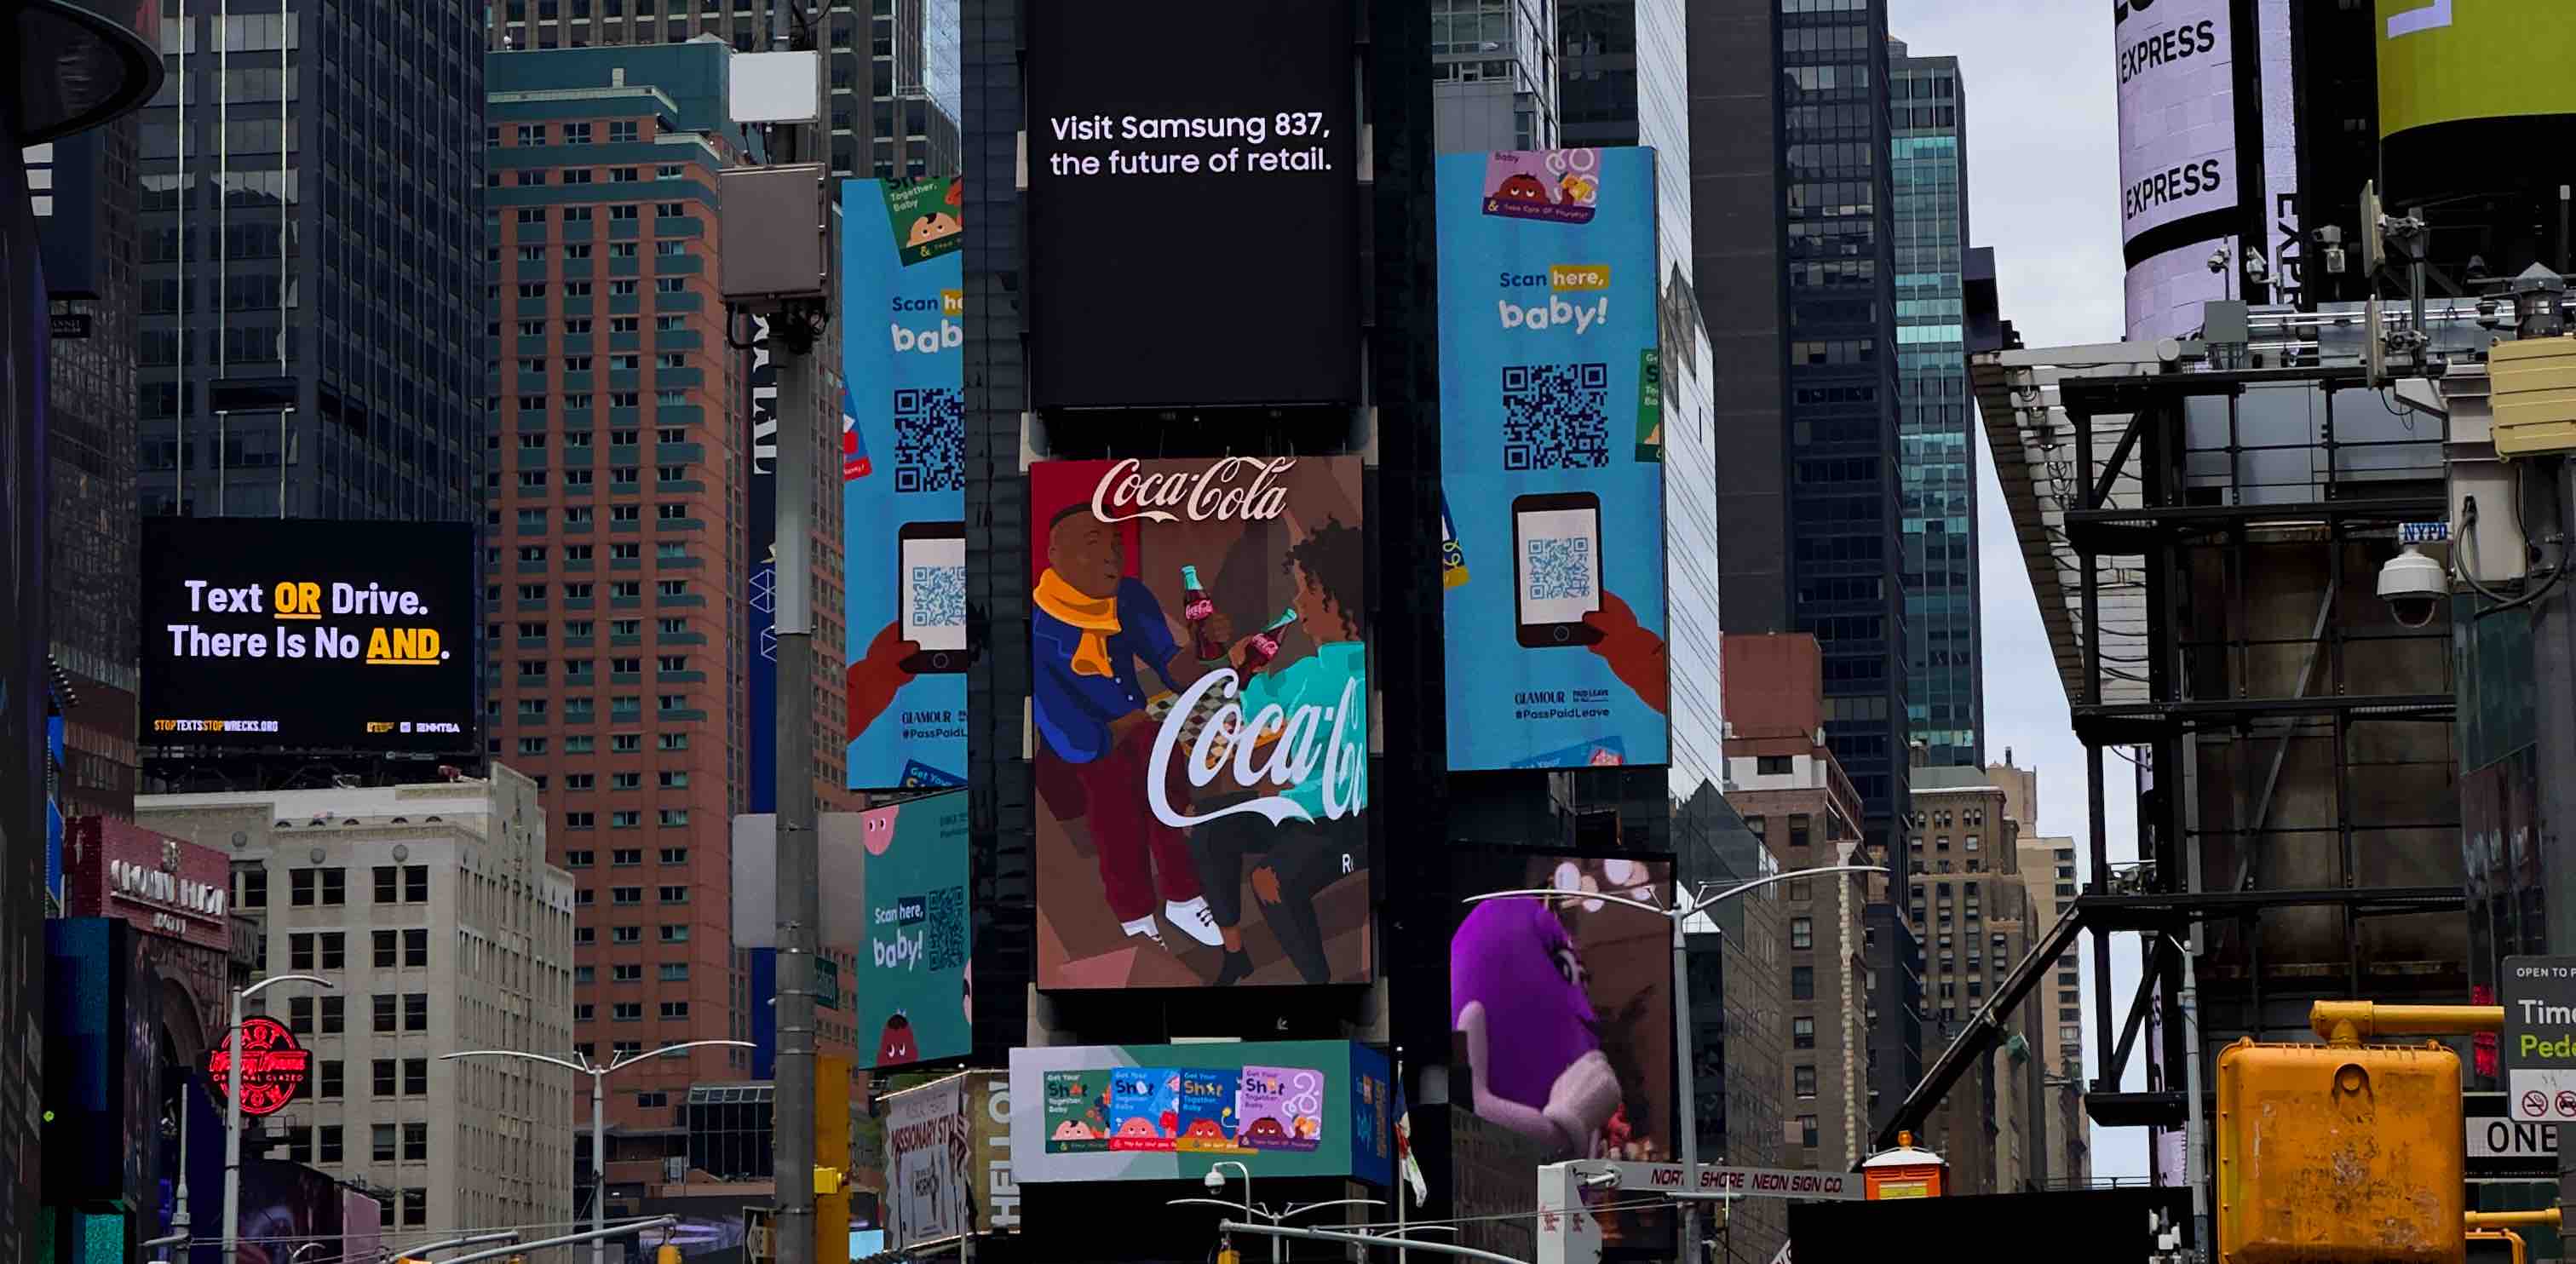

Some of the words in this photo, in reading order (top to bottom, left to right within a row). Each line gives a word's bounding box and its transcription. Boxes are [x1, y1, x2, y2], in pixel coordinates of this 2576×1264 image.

[2121, 20, 2215, 84] EXPRESS
[1050, 115, 1113, 141] Visit
[1121, 116, 1266, 144] Samsung
[1274, 112, 1330, 139] 837,
[1049, 152, 1101, 175] the
[1108, 150, 1200, 175] future
[1208, 147, 1239, 172] of
[1247, 147, 1332, 172] retail.
[2126, 158, 2221, 221] EXPRESS
[894, 199, 918, 212] Baby
[1499, 271, 1547, 288] Scan
[1552, 268, 1605, 287] here,
[892, 296, 940, 312] Scan
[1498, 295, 1609, 335] baby!
[1091, 456, 1297, 524] Coca-Cola
[2405, 524, 2447, 542] NYPD
[184, 579, 264, 613] Text
[273, 581, 322, 619] OR
[332, 582, 428, 615] Drive.
[167, 624, 267, 658] There
[276, 626, 307, 658] Is
[314, 626, 360, 659] No
[365, 627, 451, 665] AND.
[1514, 691, 1566, 705] GLAMOUR
[901, 710, 952, 724] GLAMOUR
[1515, 708, 1610, 720] #PassPaidLeave
[874, 907, 898, 924] Scan
[899, 903, 924, 921] here,
[873, 928, 924, 973] baby!
[2516, 967, 2549, 978] OPEN
[2552, 967, 2567, 978] TO
[1049, 1082, 1089, 1098] Sht
[1116, 1080, 1155, 1096] Sht
[1184, 1080, 1223, 1097] Sht
[1245, 1077, 1285, 1095] Sht
[890, 1117, 938, 1158] MISSIONARY
[2487, 1121, 2558, 1153] ONE
[1651, 1169, 1685, 1186] NORT
[1700, 1171, 1745, 1189] SHORE
[1751, 1175, 1790, 1192] NEON
[1791, 1175, 1822, 1192] SIGN
[1825, 1176, 1844, 1193] CO.
